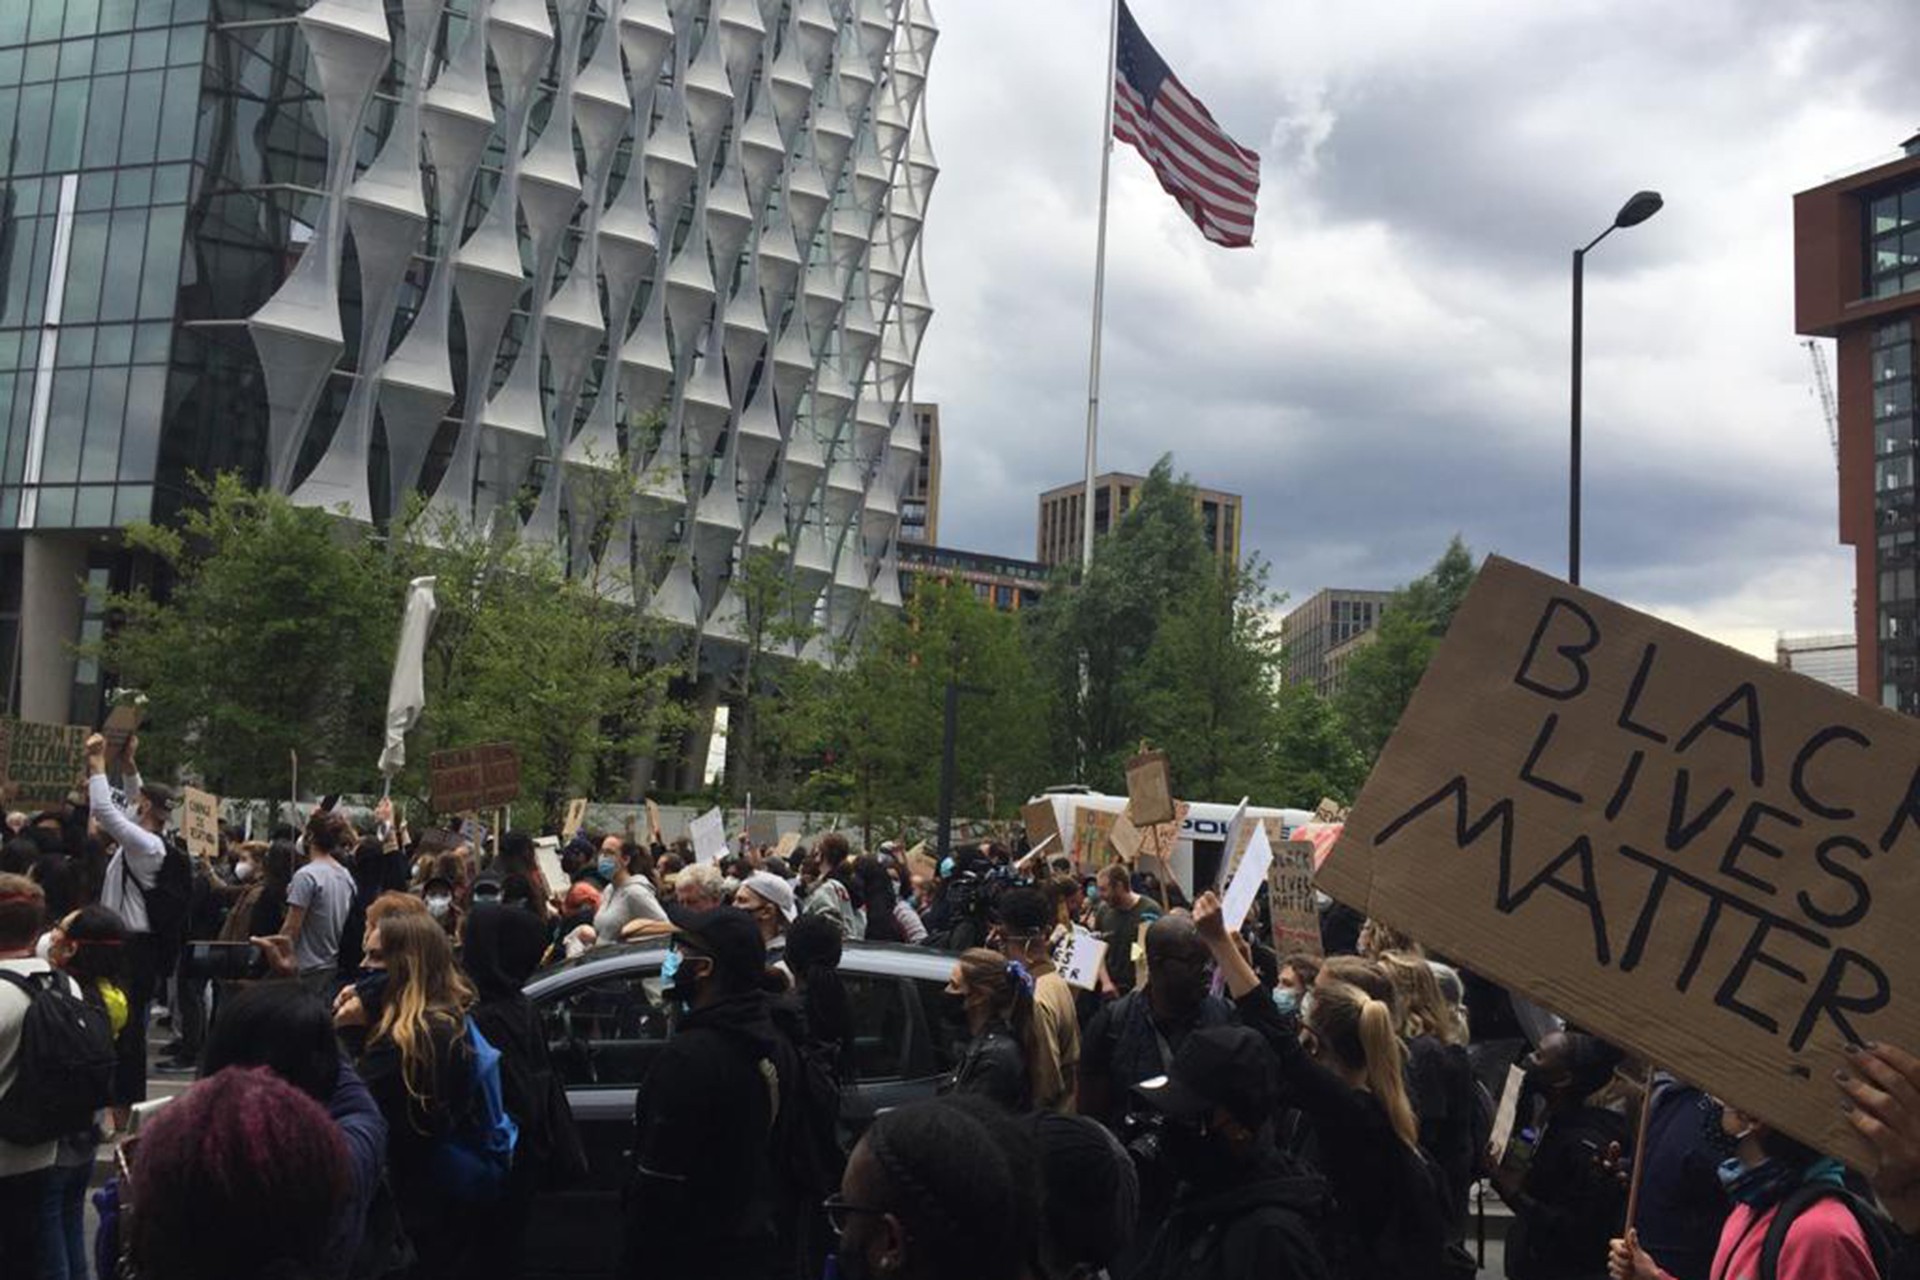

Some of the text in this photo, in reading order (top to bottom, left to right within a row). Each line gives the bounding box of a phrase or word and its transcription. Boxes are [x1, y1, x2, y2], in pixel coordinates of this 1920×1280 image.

[1273, 875, 1312, 896] LIVES
[1373, 774, 1892, 1052] MATTER
[1519, 712, 1872, 928] LIVES
